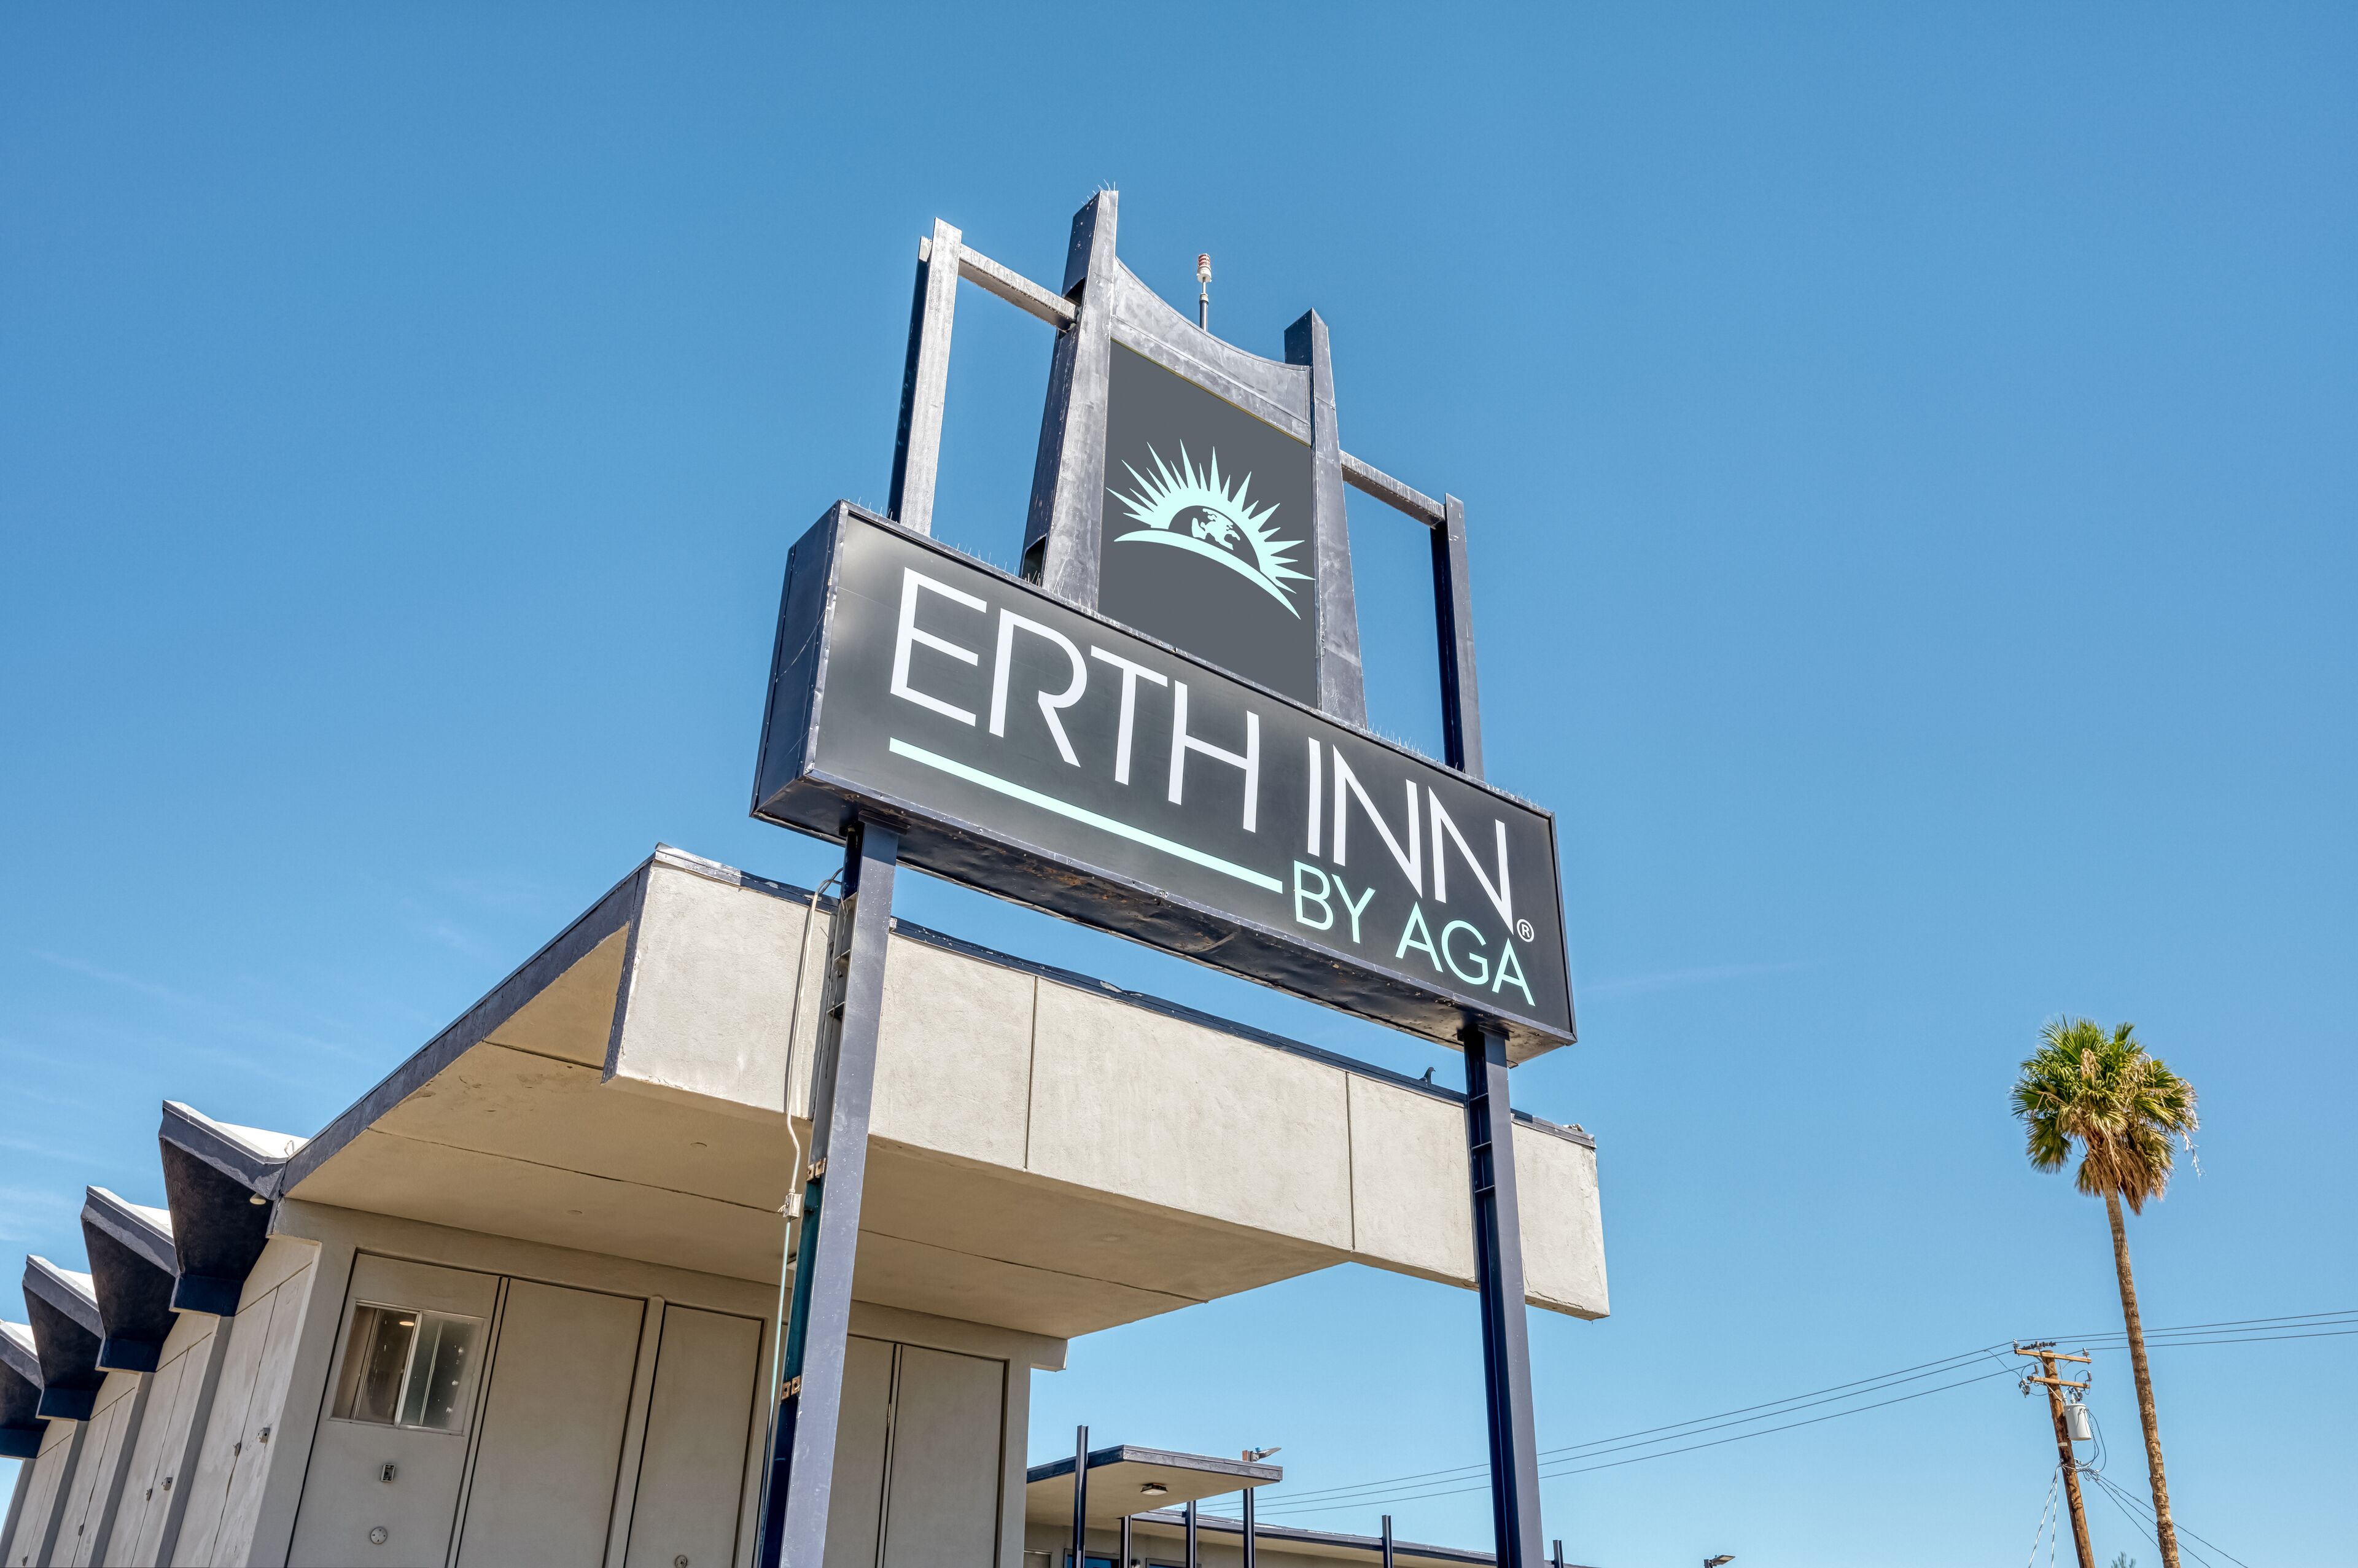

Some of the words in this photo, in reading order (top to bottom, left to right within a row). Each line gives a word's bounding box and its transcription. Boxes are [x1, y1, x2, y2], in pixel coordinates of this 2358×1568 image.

[890, 567, 1260, 833] ERTH
[1293, 860, 1376, 944] BY
[1395, 901, 1536, 1007] AGA
